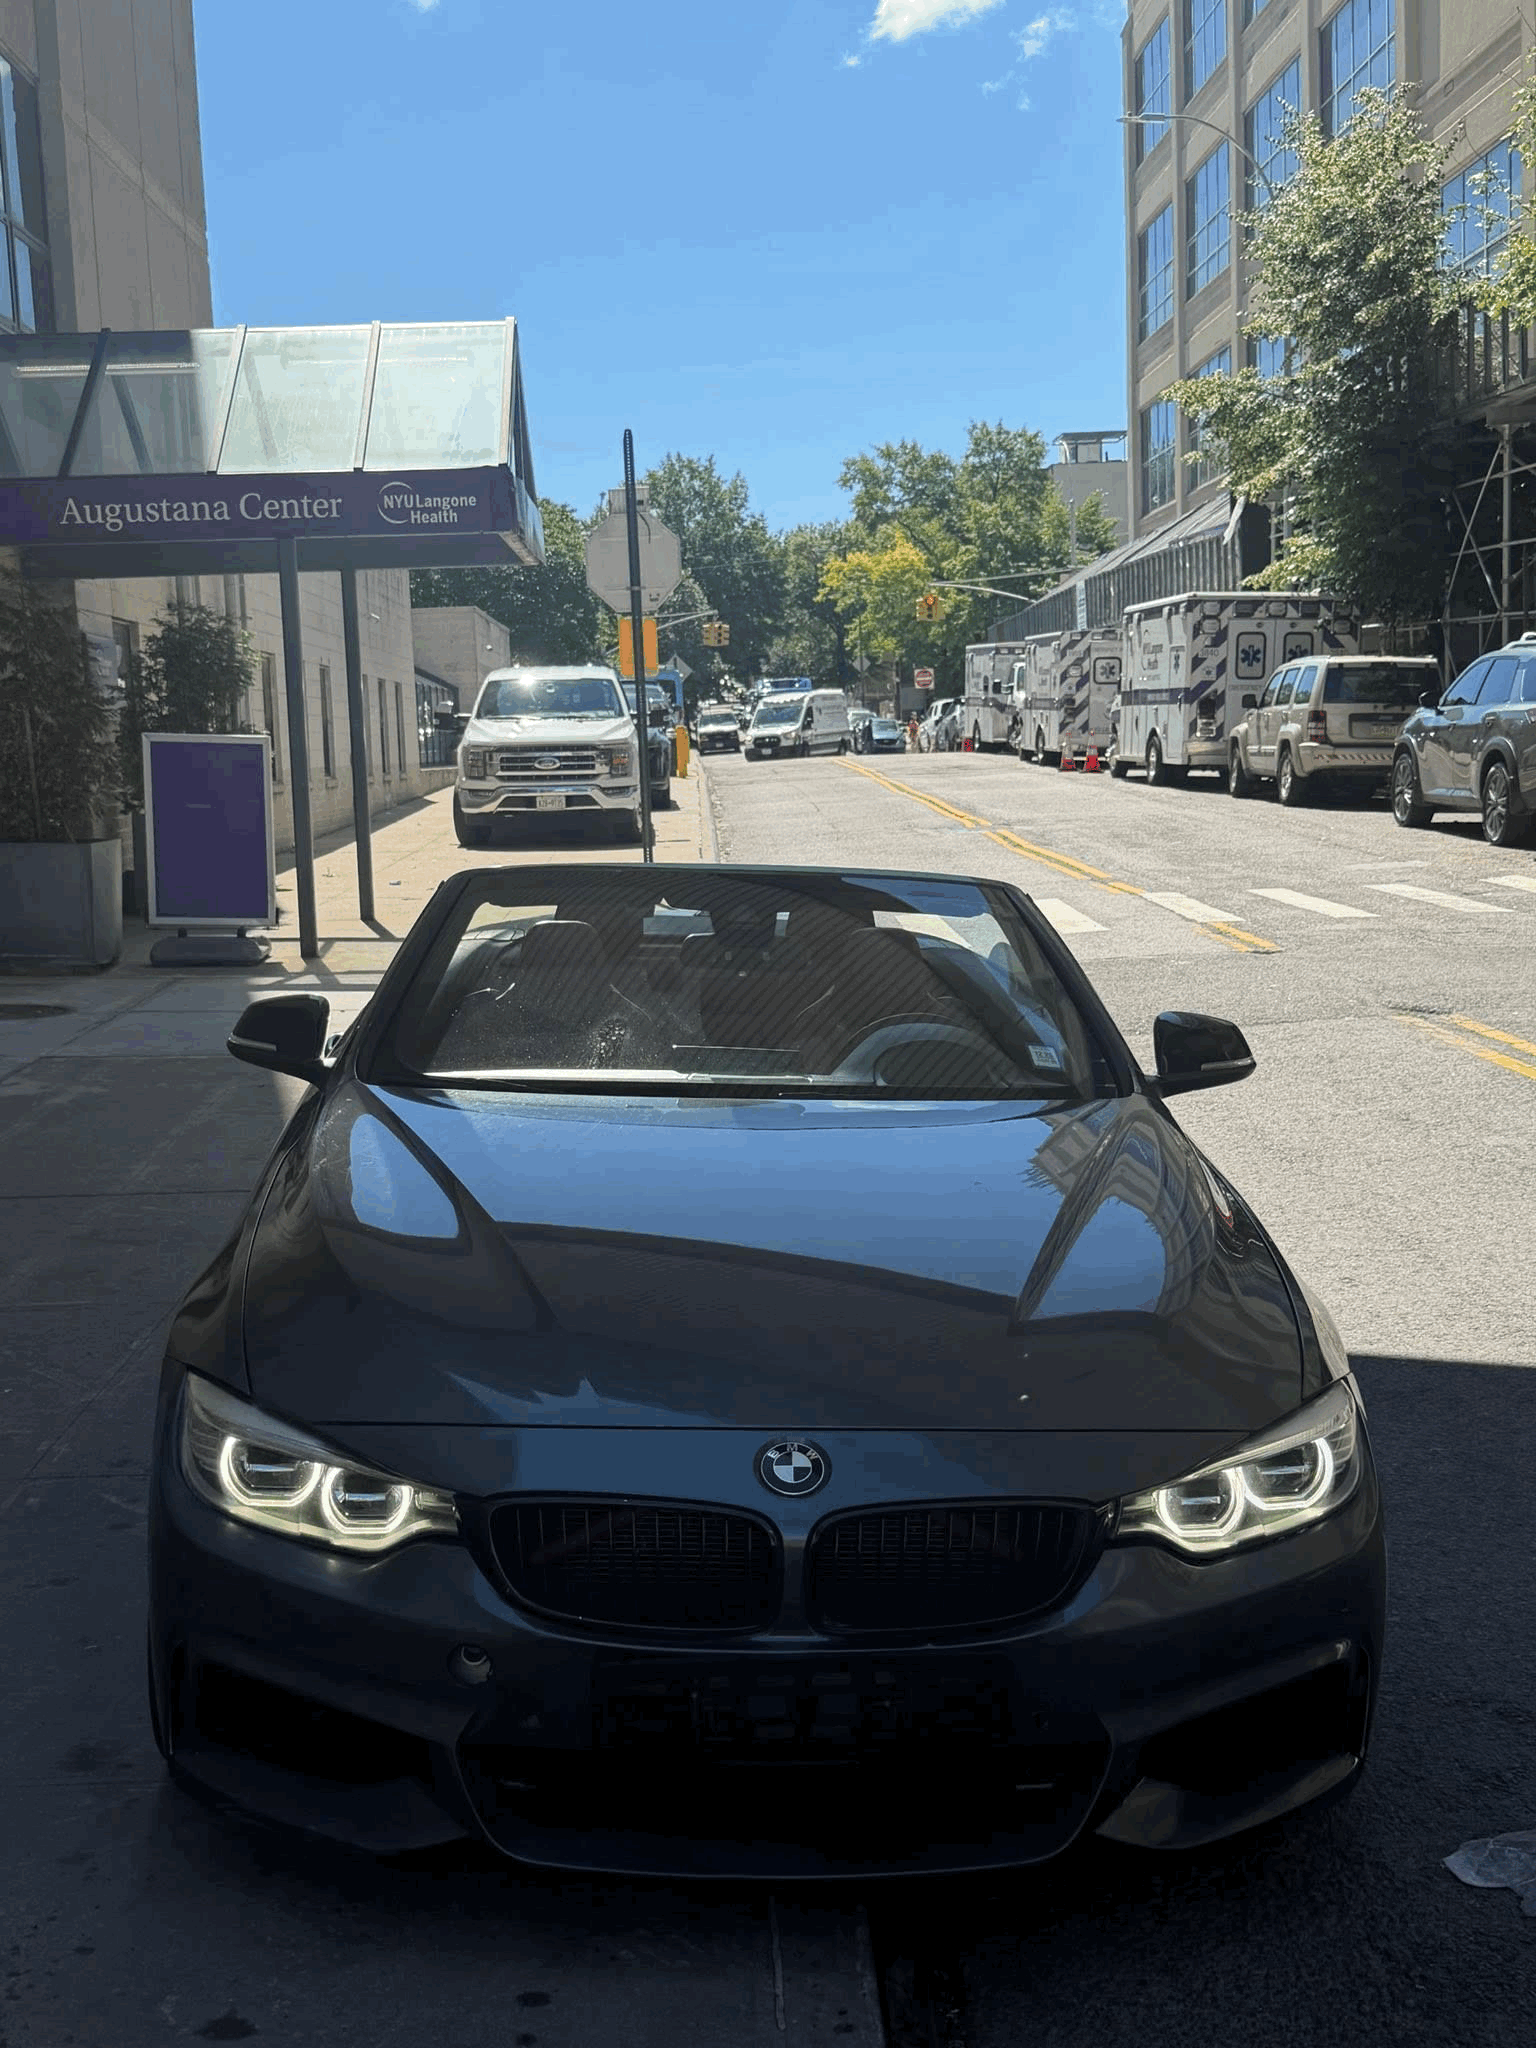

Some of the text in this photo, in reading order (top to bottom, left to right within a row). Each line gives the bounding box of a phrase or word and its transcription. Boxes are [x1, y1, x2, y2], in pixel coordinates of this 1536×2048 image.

[60, 492, 342, 532] Augustana Center
[410, 509, 458, 524] Health
